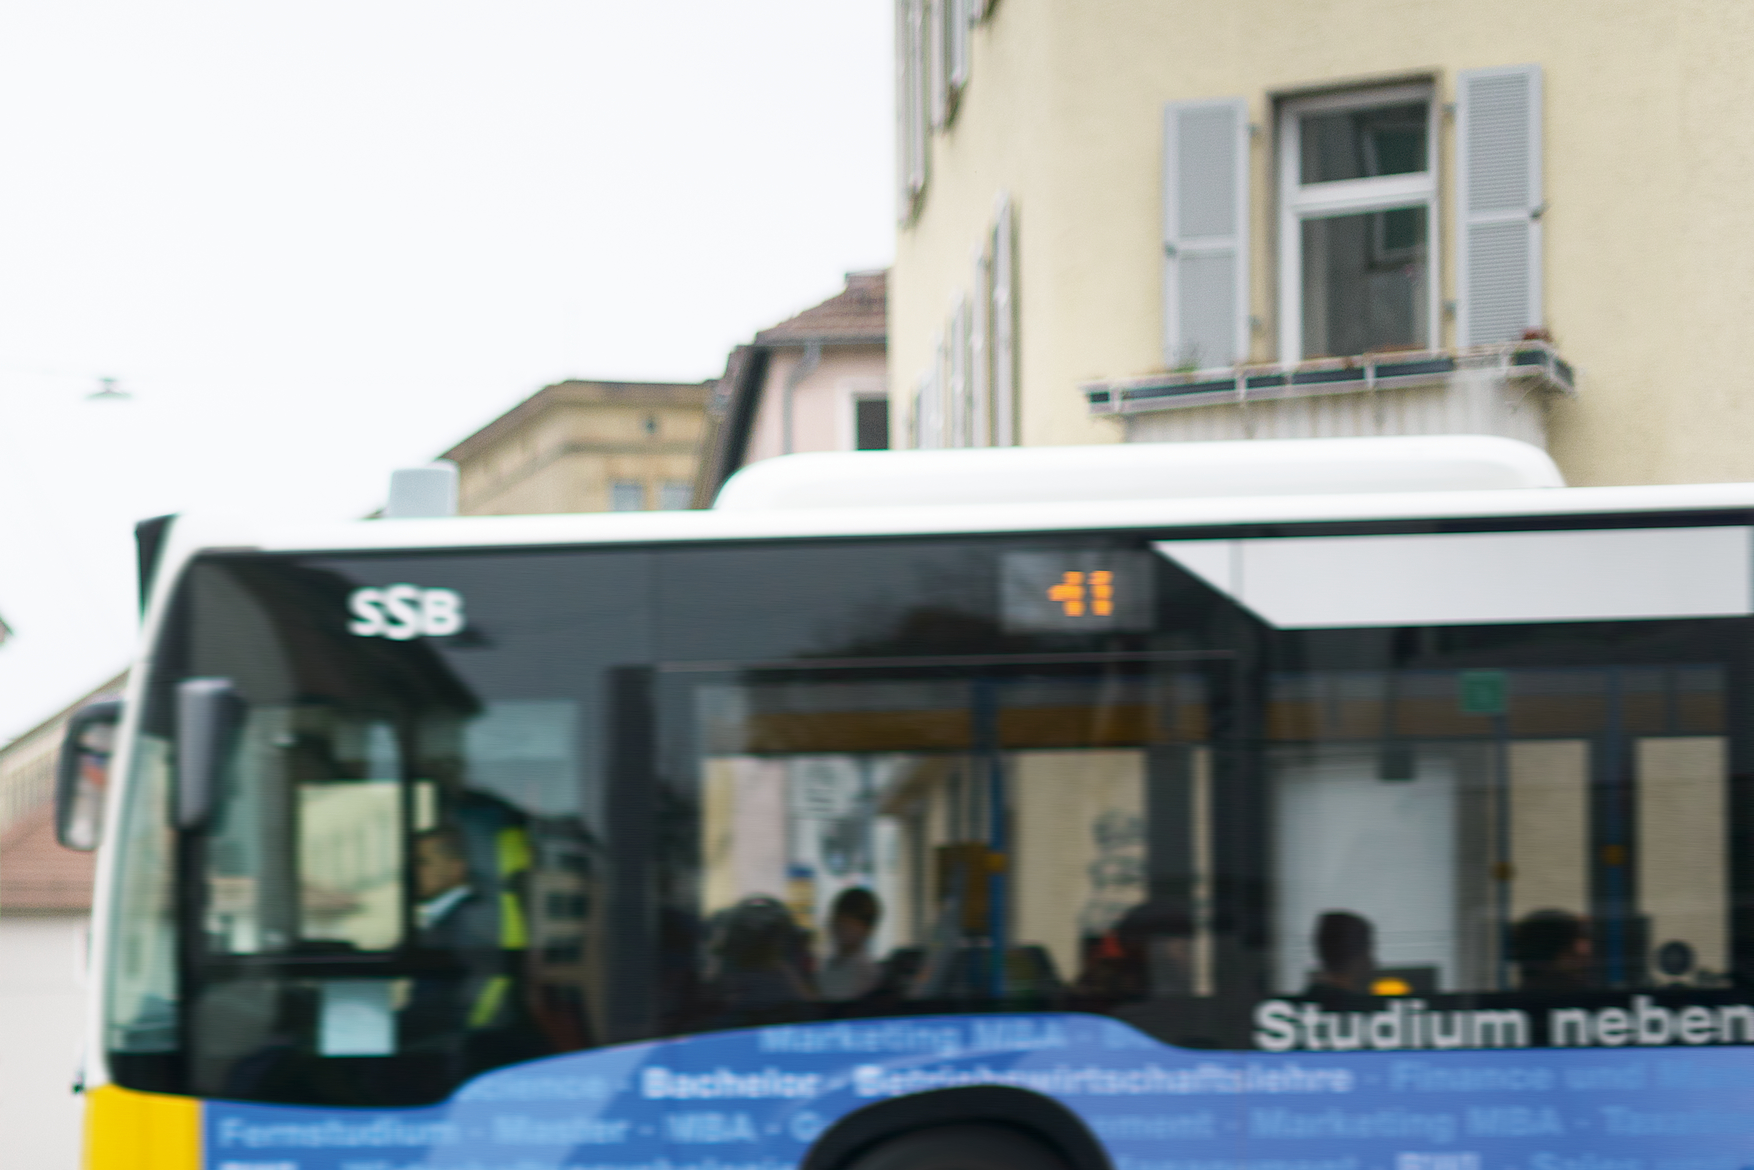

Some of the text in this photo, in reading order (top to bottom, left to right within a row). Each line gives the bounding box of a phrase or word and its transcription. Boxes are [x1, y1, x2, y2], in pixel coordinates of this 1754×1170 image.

[348, 582, 465, 641] SSB
[1254, 994, 1754, 1052] Studium neben
[642, 1066, 820, 1099] Bachelor
